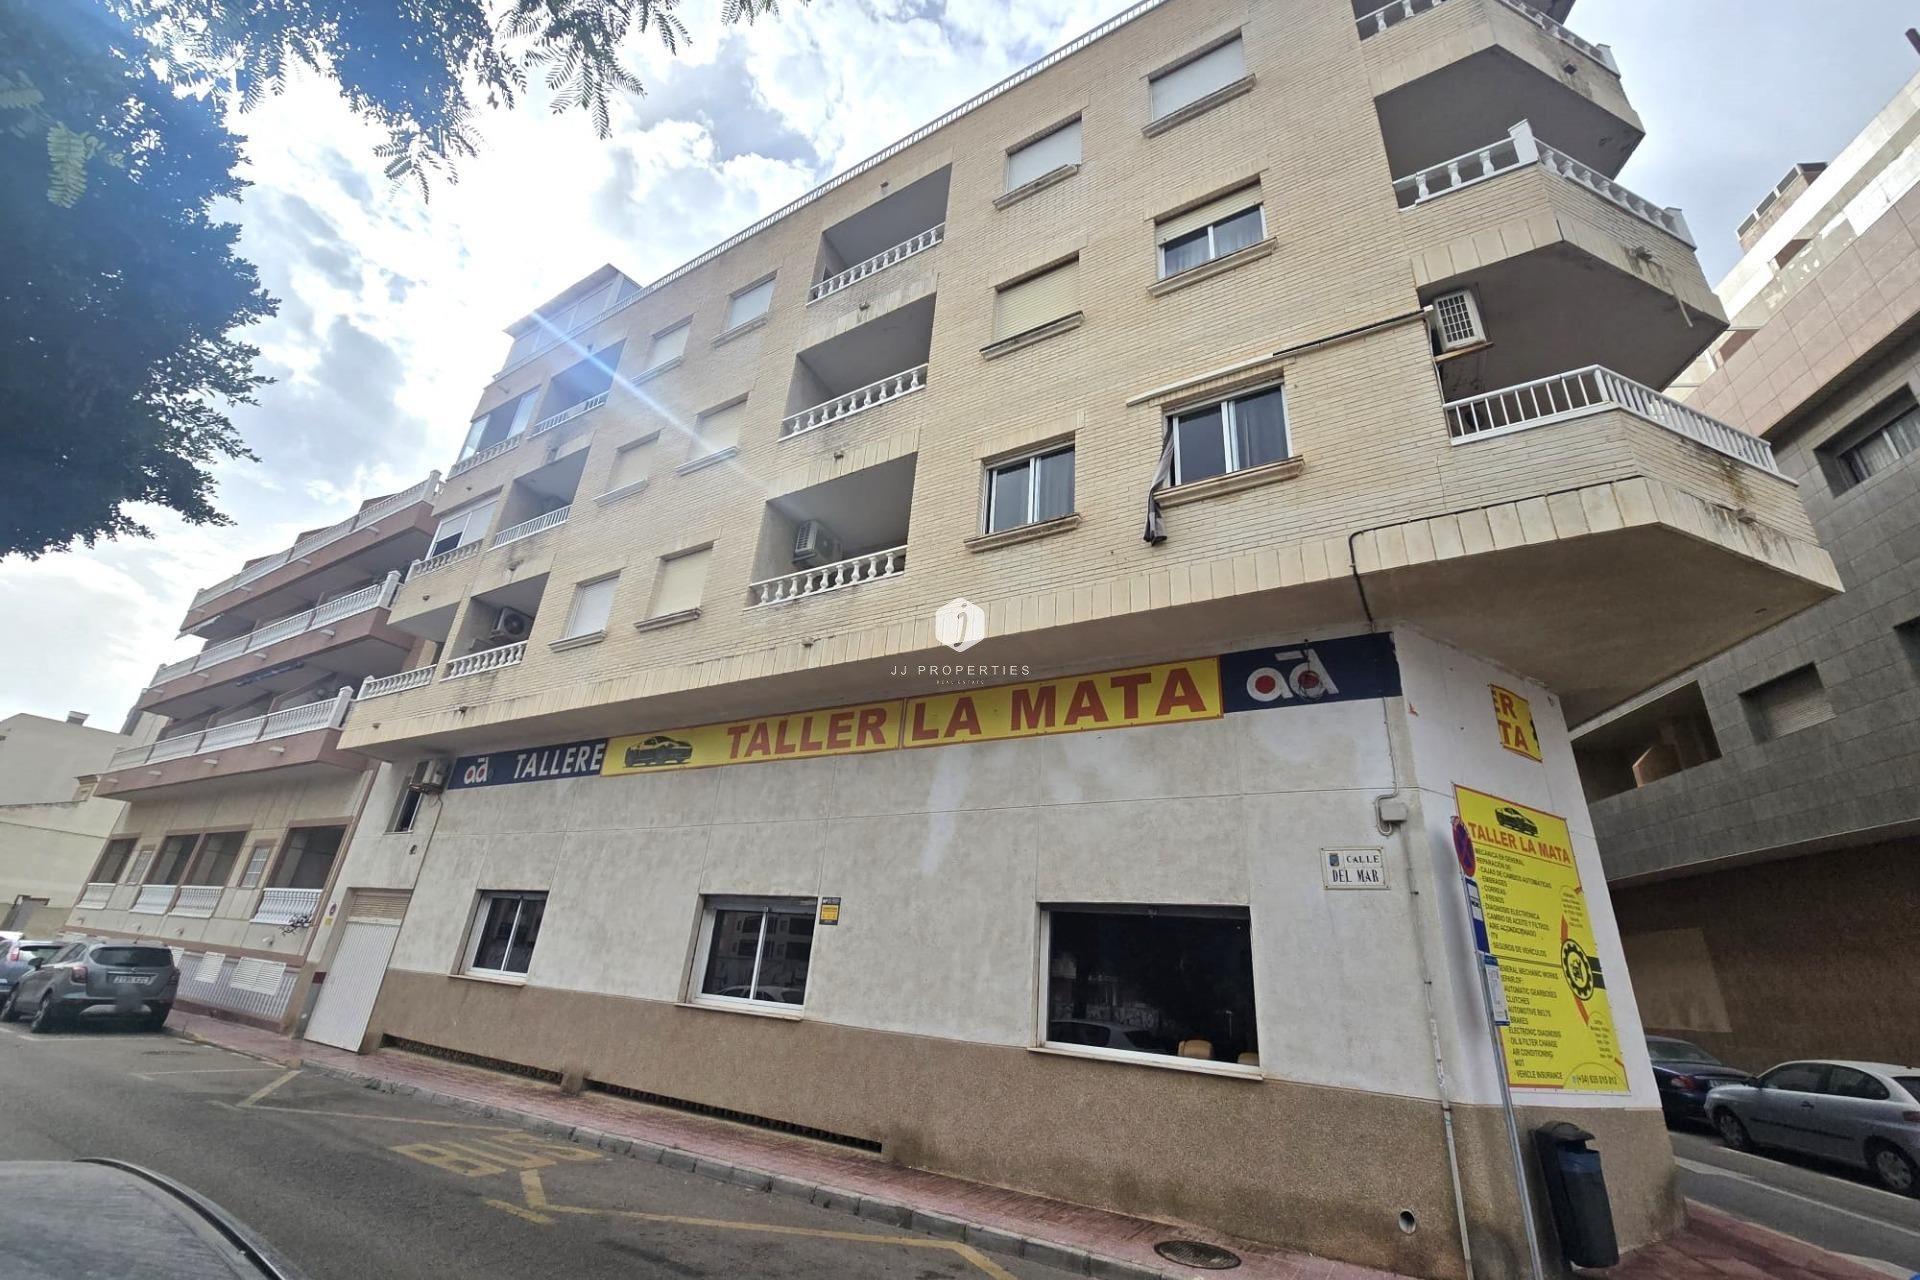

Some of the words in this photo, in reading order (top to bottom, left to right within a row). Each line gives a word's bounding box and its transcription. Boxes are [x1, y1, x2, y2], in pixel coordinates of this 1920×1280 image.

[727, 707, 888, 760] TALLER
[912, 697, 982, 741] LA
[1010, 667, 1207, 731] MATA
[1498, 719, 1529, 751] TA
[514, 743, 606, 779] TALLERE
[1467, 821, 1518, 850] TALLER
[1518, 836, 1538, 855] LA
[1537, 841, 1571, 864] MATA
[1346, 855, 1380, 864] CALLE
[1332, 869, 1352, 883] DEL
[1357, 869, 1380, 883] MAR
[1485, 893, 1504, 904] FRENOS
[1505, 994, 1529, 1004] CLUTCHES
[1510, 1015, 1528, 1025] BRAKES
[1508, 1025, 1537, 1036] ELECTRONIC
[1510, 1035, 1518, 1044] OIL
[1521, 1037, 1538, 1047] FILTER
[1538, 1038, 1558, 1049] CHANGE
[1512, 1047, 1520, 1055] AIR
[1520, 1048, 1553, 1058] CONDITIONING
[1515, 1069, 1536, 1079] VEHICLE
[1536, 1070, 1563, 1081] INSURANCE
[388, 1132, 604, 1178] BUS
